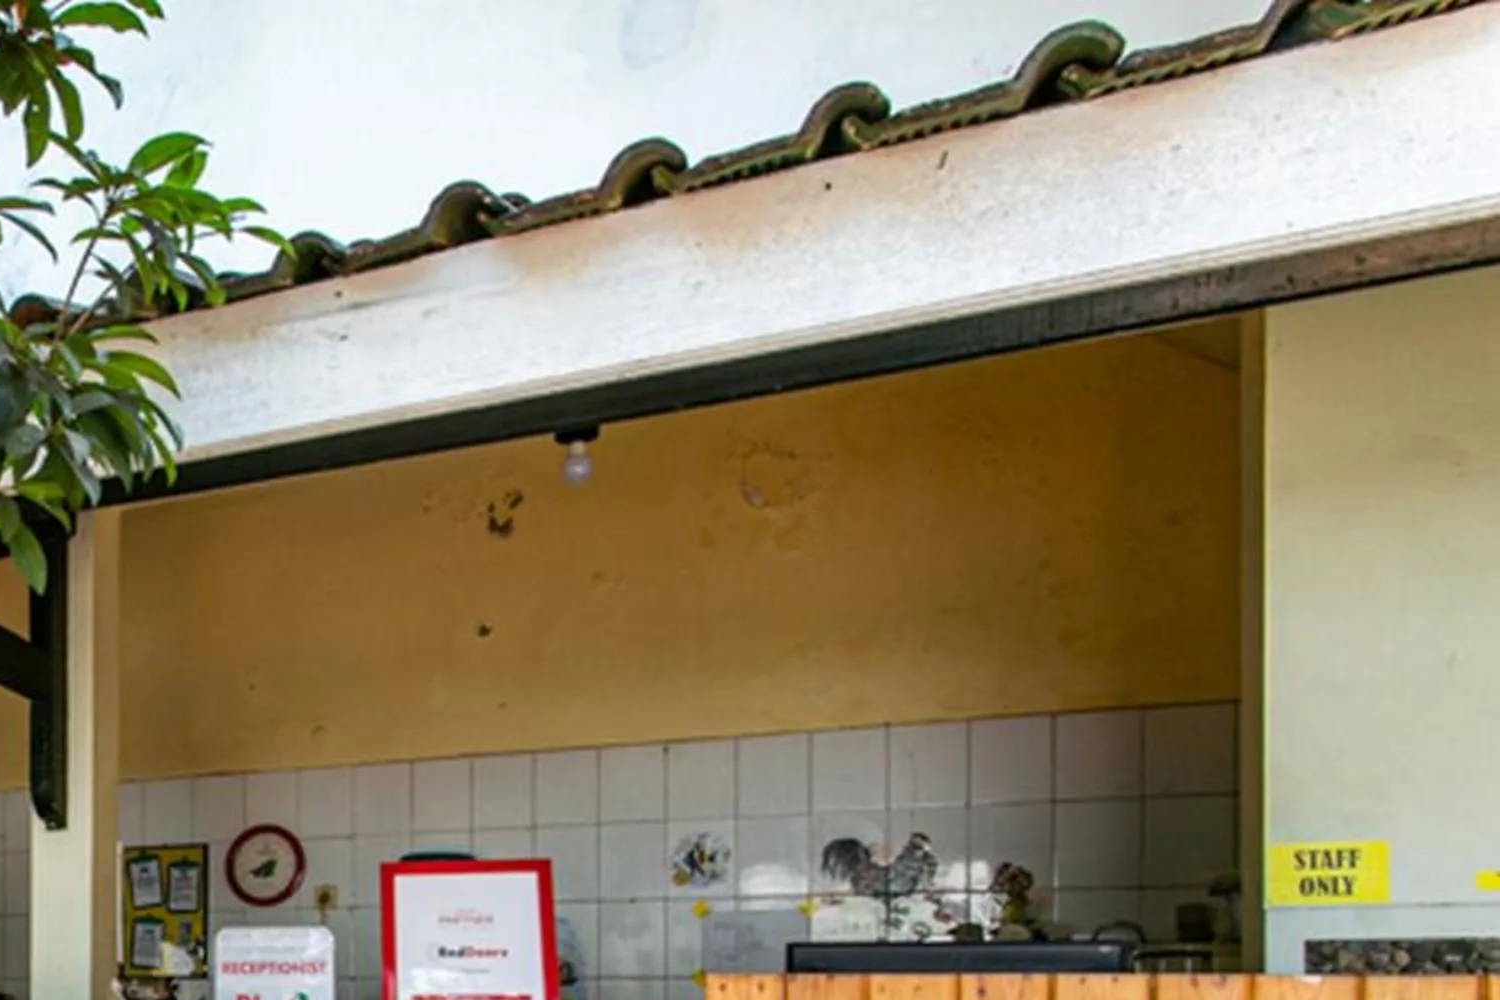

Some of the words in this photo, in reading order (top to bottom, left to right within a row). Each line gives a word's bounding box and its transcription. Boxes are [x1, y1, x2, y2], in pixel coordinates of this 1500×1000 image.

[1293, 849, 1361, 870] STAFF
[1299, 876, 1357, 896] ONLY
[222, 960, 328, 975] RECEPTIONIST
